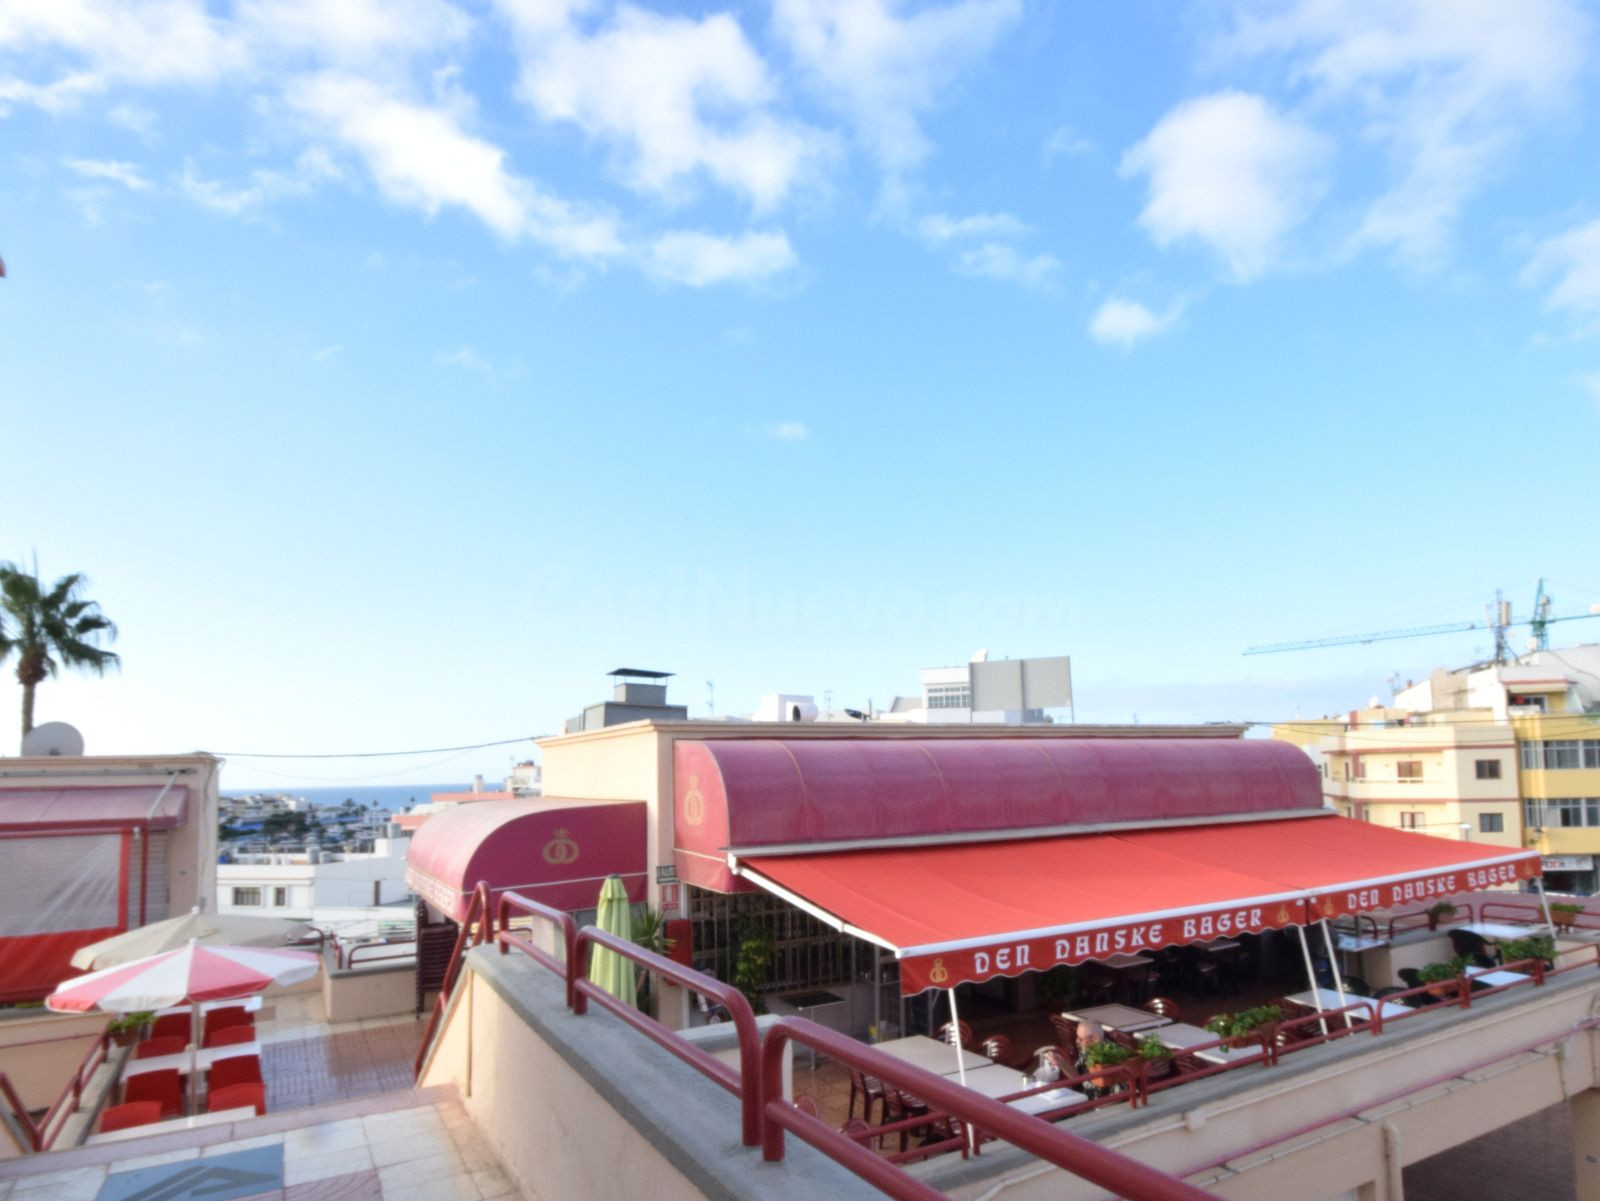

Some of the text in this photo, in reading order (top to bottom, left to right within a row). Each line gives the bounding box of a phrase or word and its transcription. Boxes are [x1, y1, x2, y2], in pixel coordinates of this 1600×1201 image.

[1347, 888, 1380, 909] DEN
[1392, 876, 1456, 902] DANSKE
[1467, 864, 1516, 888] BAGER
[974, 909, 1262, 974] DEN DANSKE BAGER
